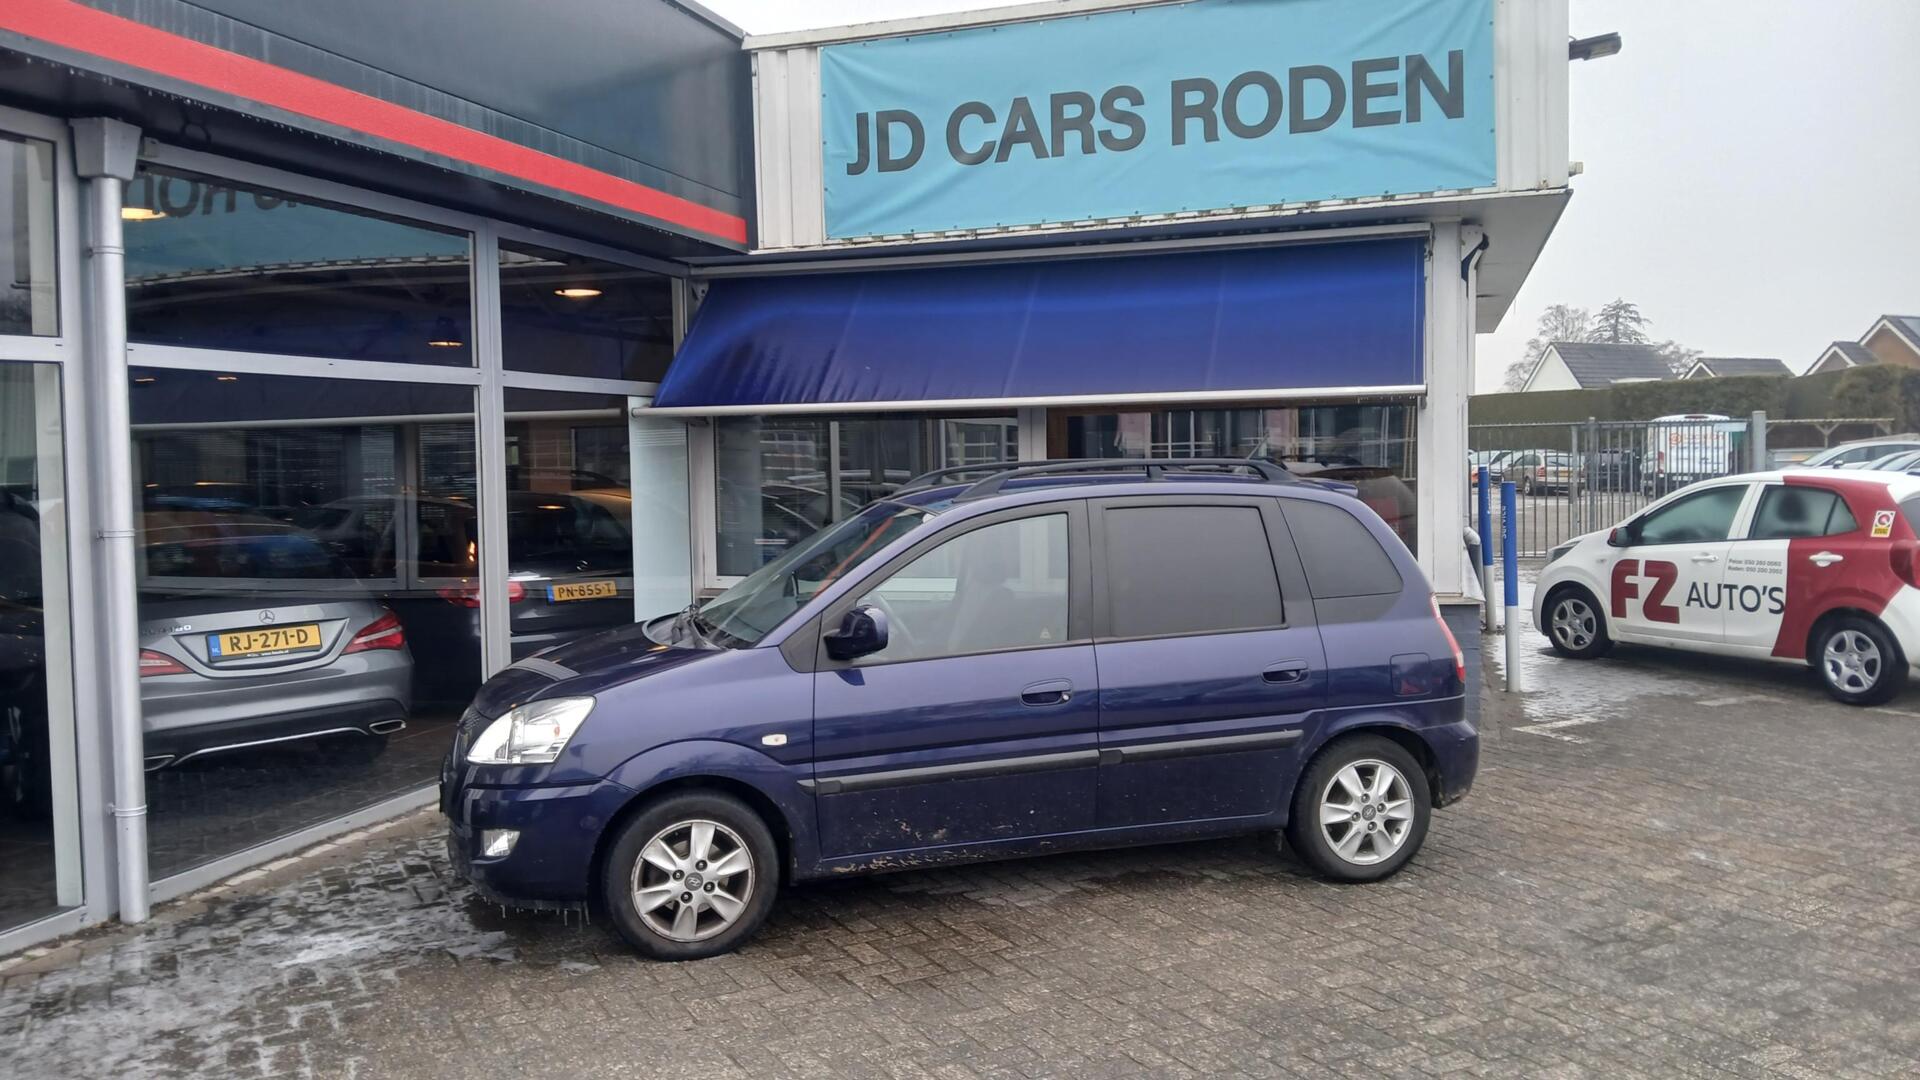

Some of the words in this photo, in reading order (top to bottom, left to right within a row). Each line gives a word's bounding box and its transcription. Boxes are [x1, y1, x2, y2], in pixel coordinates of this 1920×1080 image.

[846, 109, 926, 176] JD
[945, 84, 1147, 166] CARS
[1170, 48, 1465, 146] RODEN
[1610, 558, 1680, 624] FZ
[1685, 581, 1786, 615] AUTO'S
[229, 628, 309, 652] RJ-271-D
